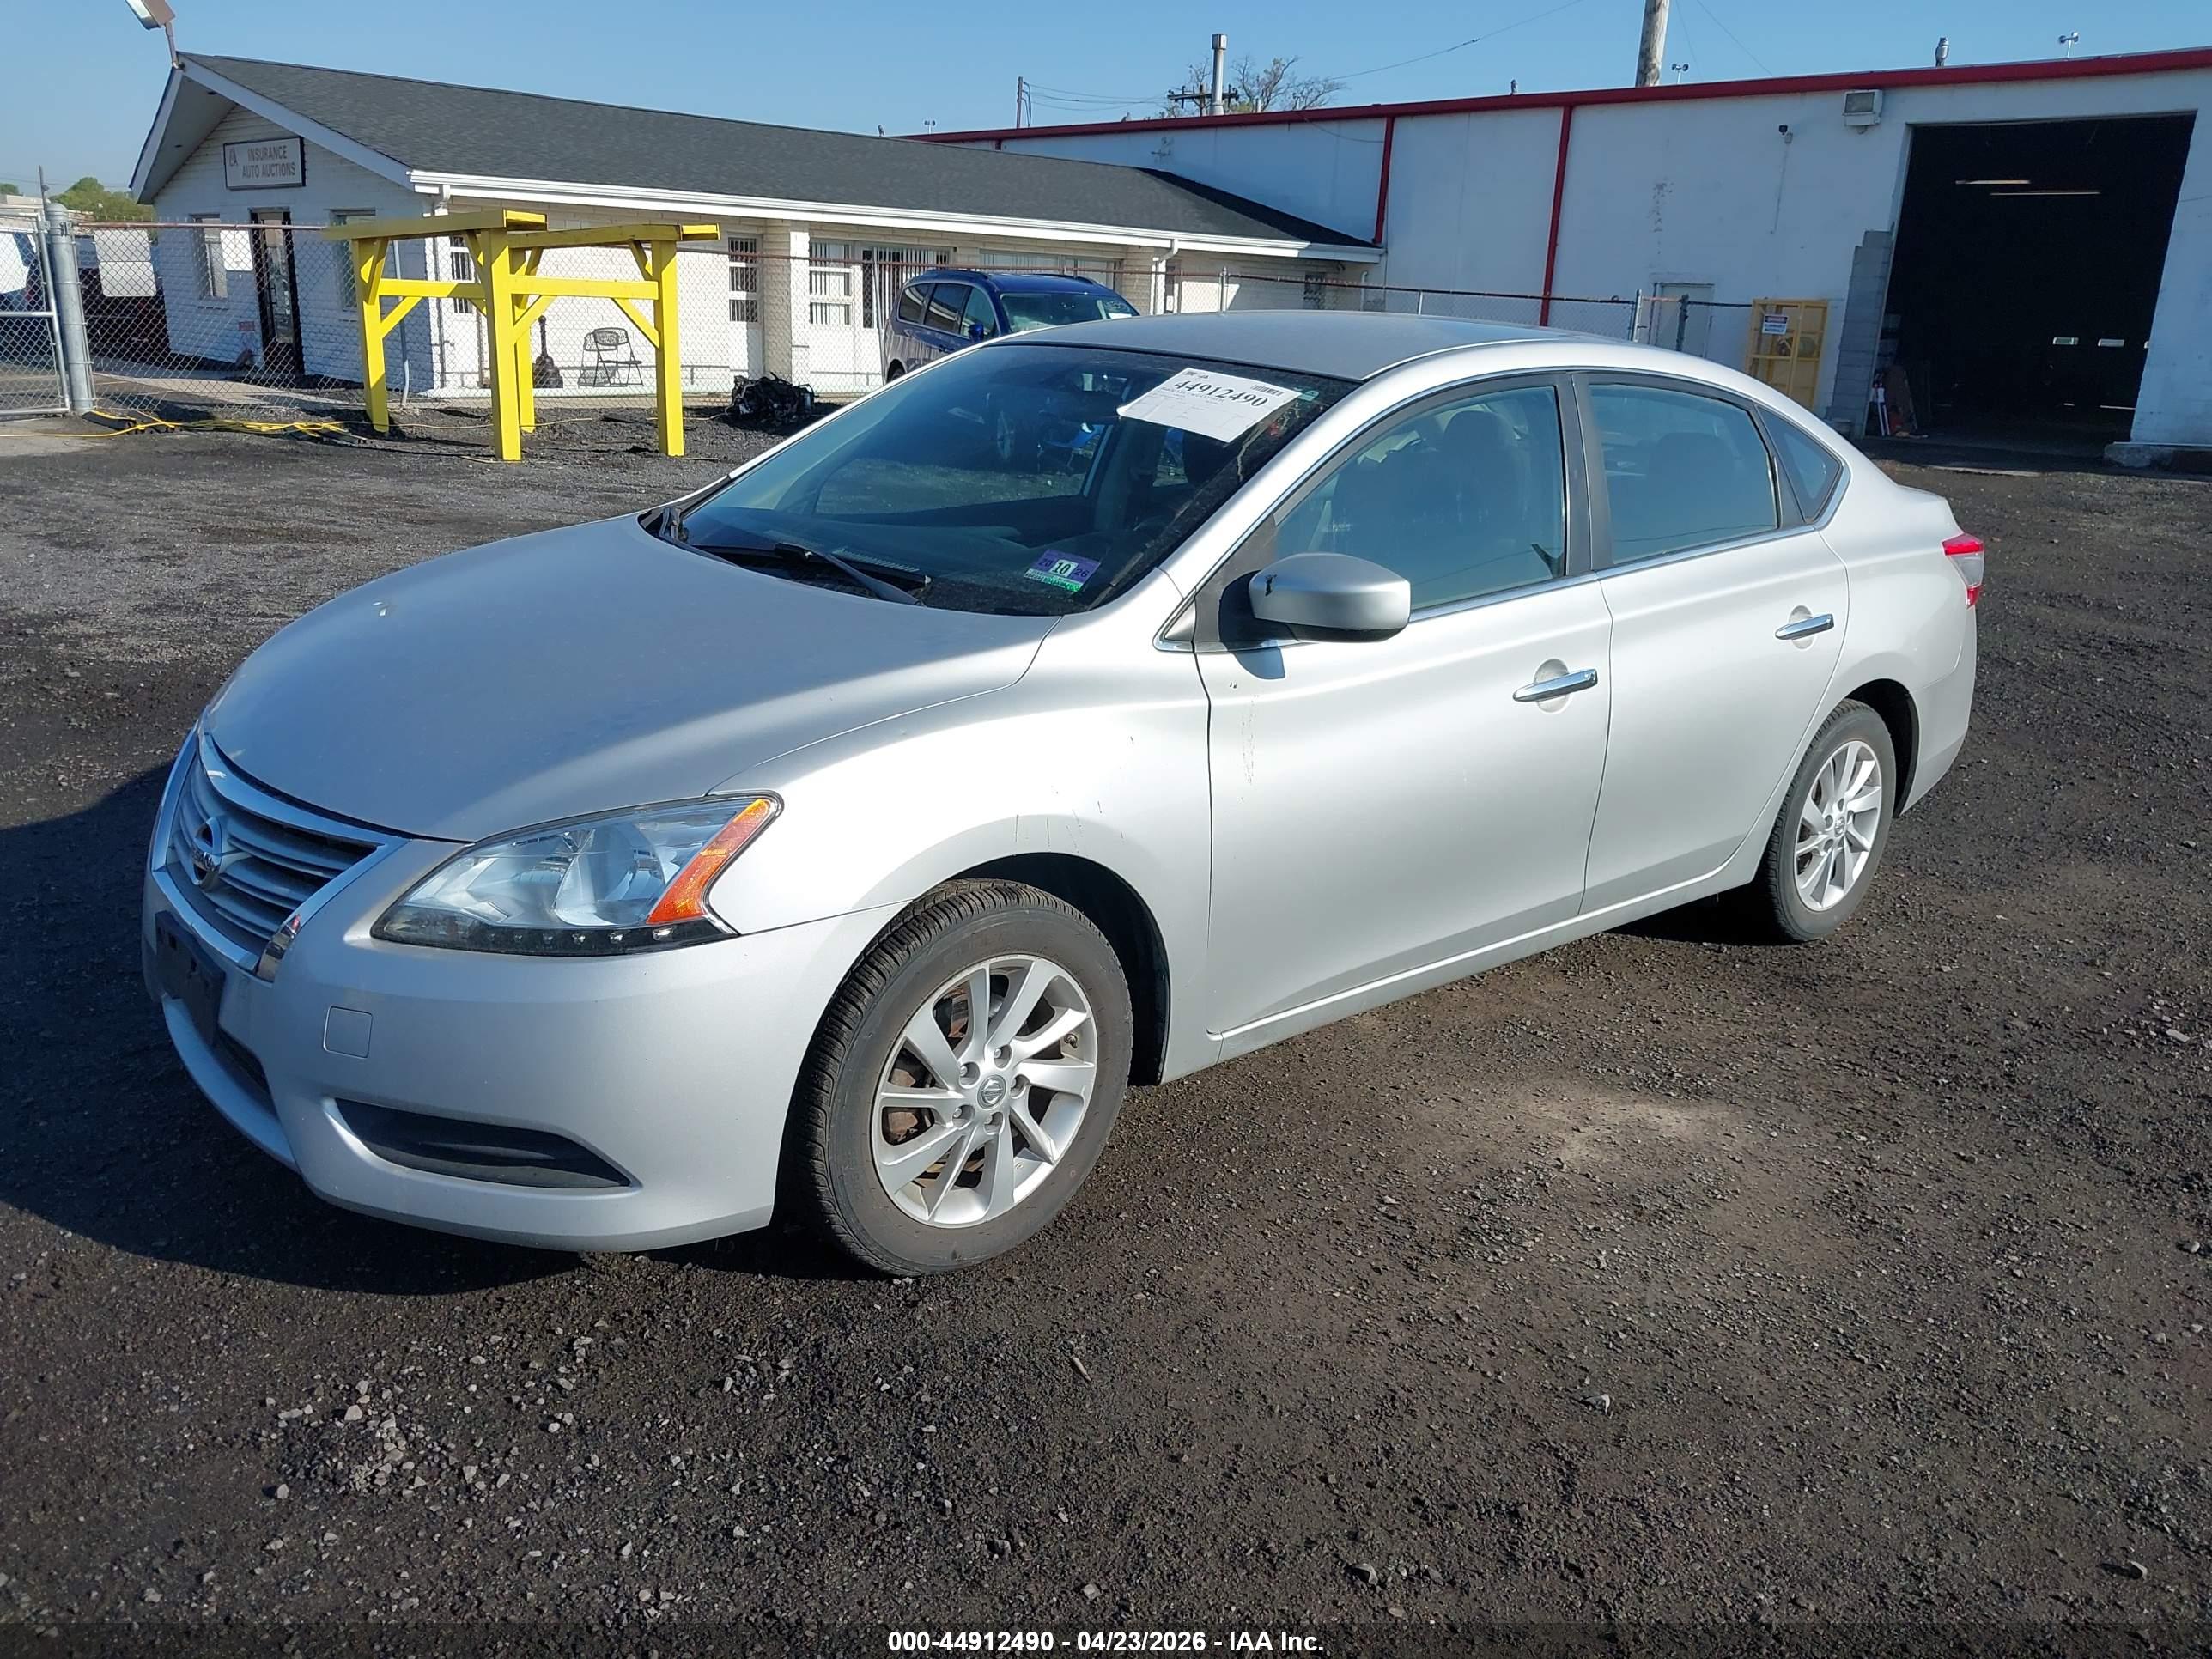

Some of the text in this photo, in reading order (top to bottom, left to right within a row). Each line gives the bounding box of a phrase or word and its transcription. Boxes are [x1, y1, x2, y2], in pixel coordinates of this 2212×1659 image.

[247, 145, 287, 161] INSURANCE
[242, 162, 295, 179] AUTO AUCTIONS
[1174, 380, 1268, 407] 44912490
[1051, 562, 1072, 575] 10
[1073, 568, 1090, 578] 26
